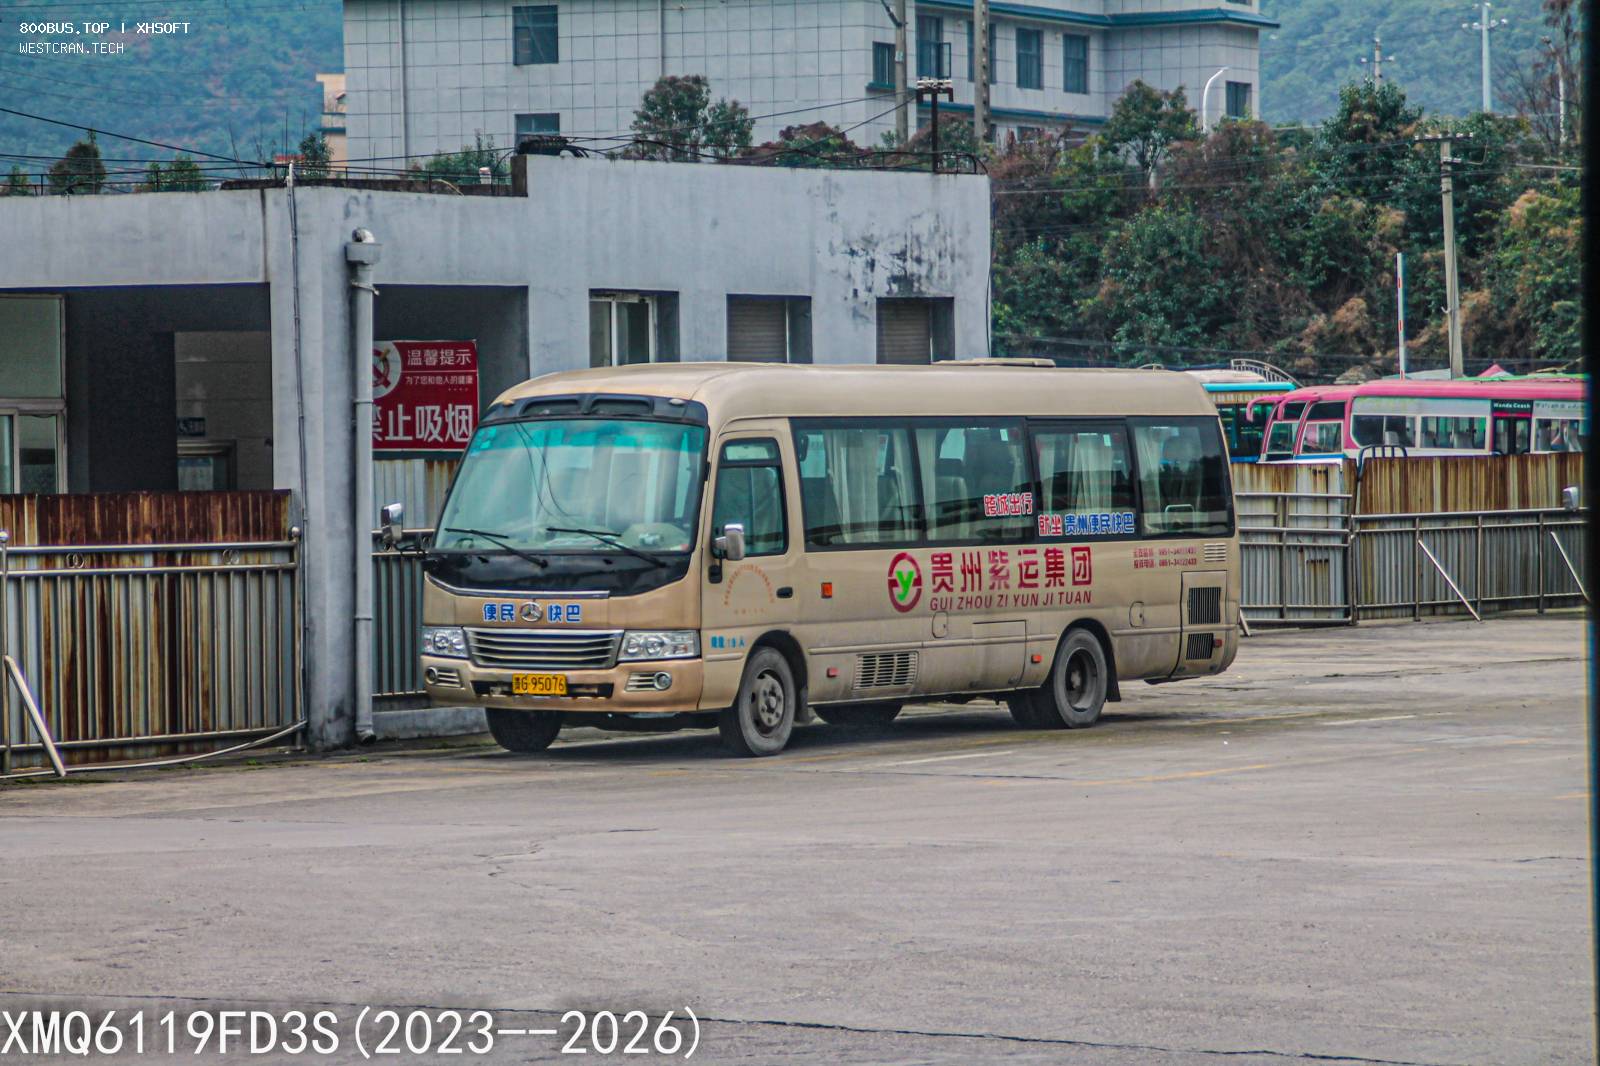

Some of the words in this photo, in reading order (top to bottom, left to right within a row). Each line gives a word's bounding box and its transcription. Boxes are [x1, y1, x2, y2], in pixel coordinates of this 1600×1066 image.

[407, 348, 472, 366] 温馨提示
[983, 492, 1032, 516] 跨城出行
[1065, 512, 1135, 535] 贵州便民快巴
[930, 546, 1093, 593] 贵州紫运集团
[930, 597, 953, 611] GUI
[957, 595, 992, 610] ZHOU
[996, 594, 1009, 608] ZI
[1013, 592, 1039, 607] YUN
[1042, 592, 1055, 606] JI
[1057, 590, 1093, 605] TUAN
[483, 603, 515, 623] 便民
[547, 604, 582, 623] 快巴
